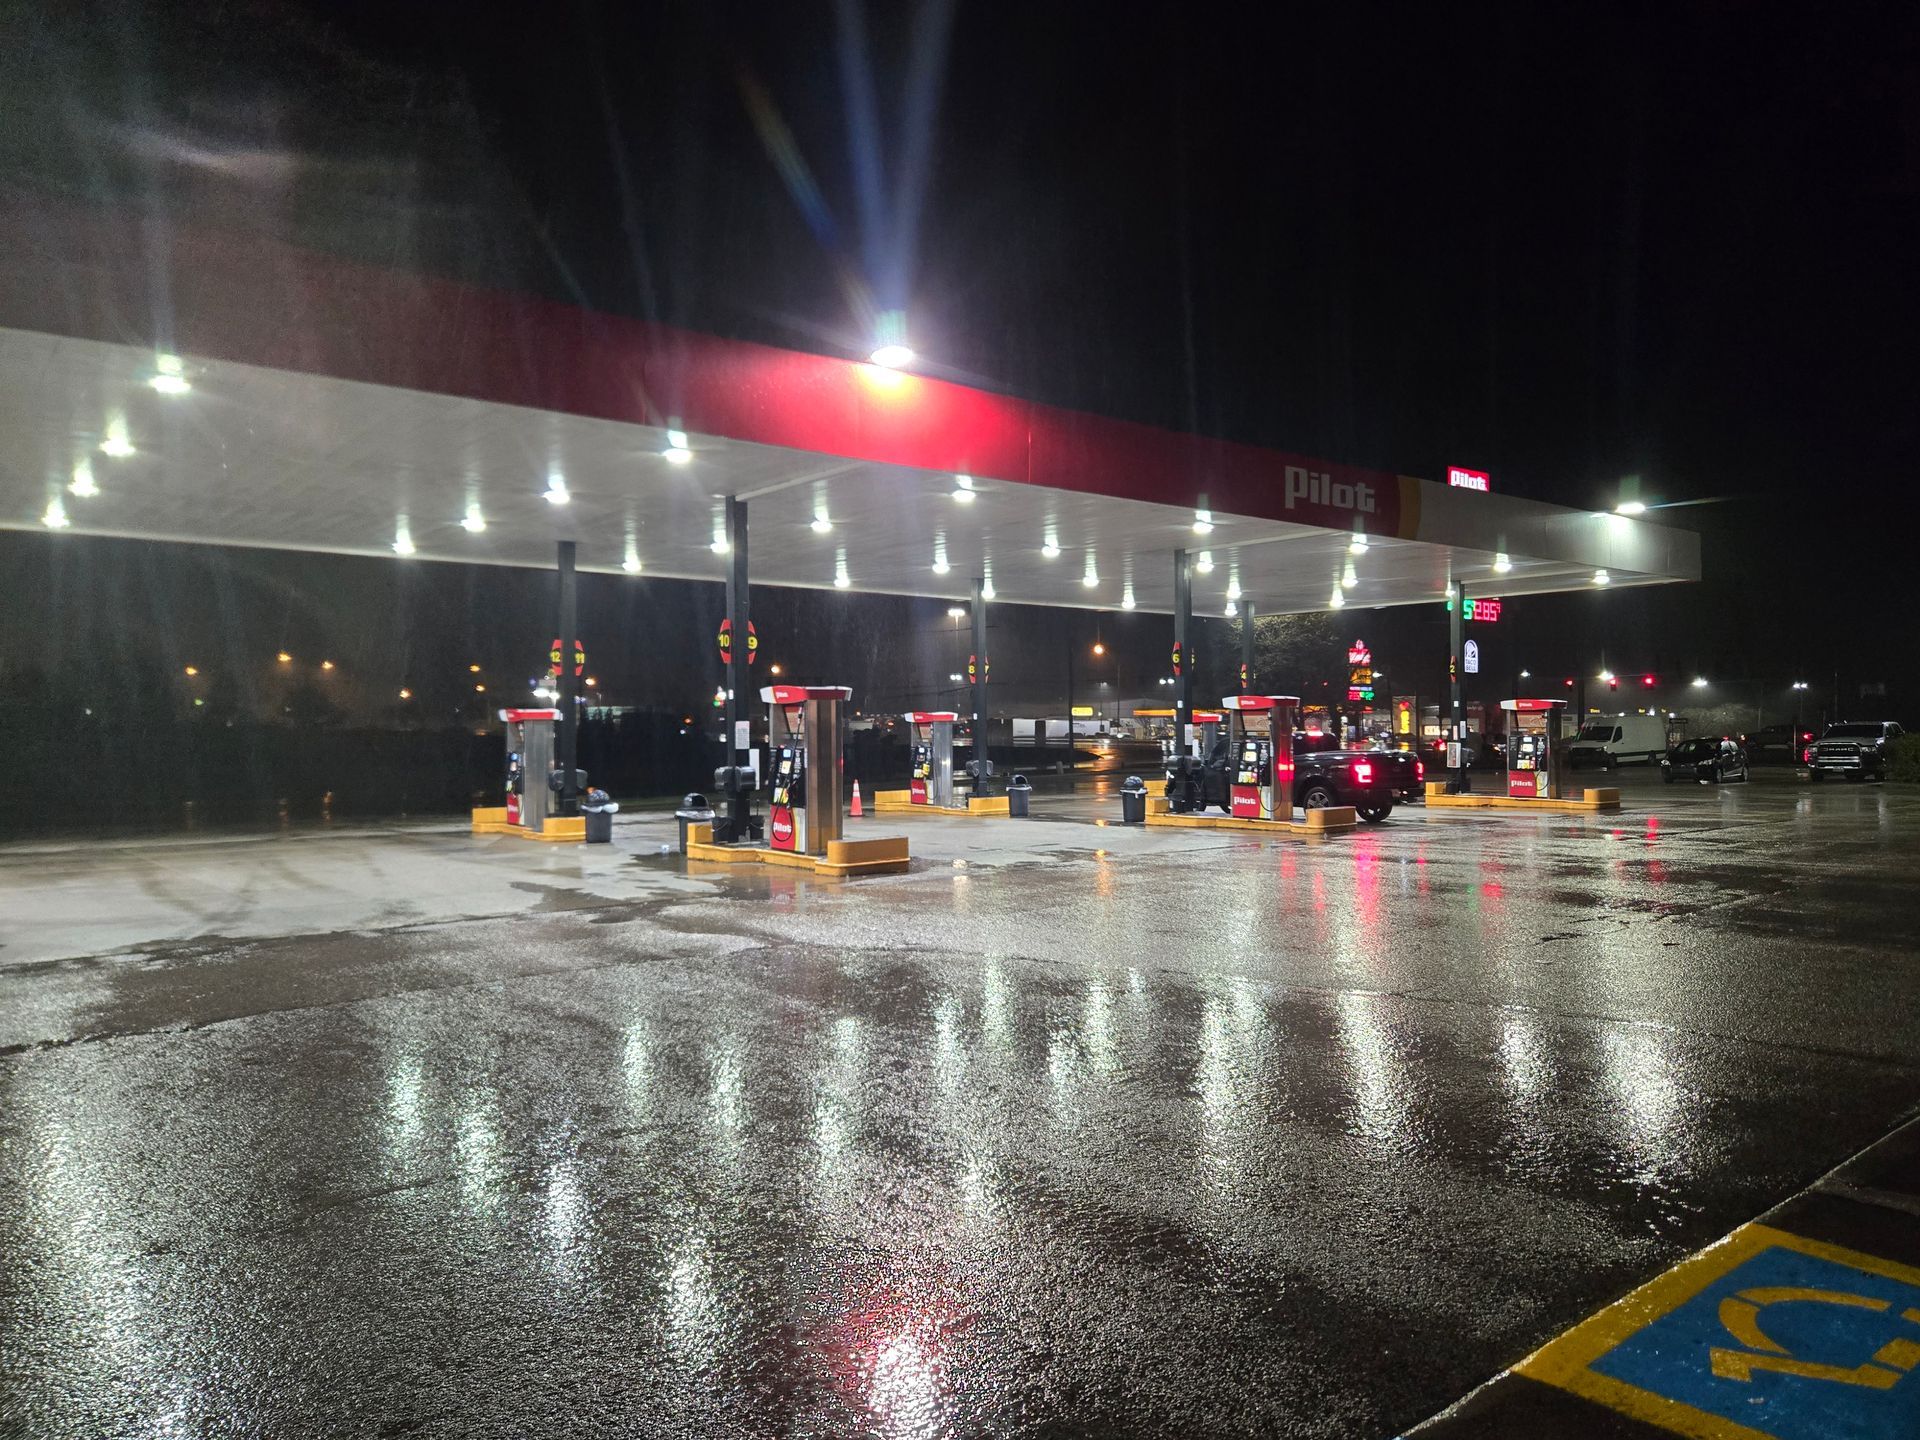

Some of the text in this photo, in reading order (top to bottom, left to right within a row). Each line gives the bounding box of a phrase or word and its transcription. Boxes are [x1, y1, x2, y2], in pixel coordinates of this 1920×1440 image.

[1450, 470, 1488, 492] Pilot
[1284, 465, 1376, 513] Pilot
[718, 633, 730, 648] 10
[747, 636, 758, 650] 9
[1172, 653, 1180, 664] 6
[968, 664, 976, 674] 8
[1449, 665, 1456, 673] 2
[1233, 796, 1256, 805] Pilot
[772, 821, 792, 833] Pilot
